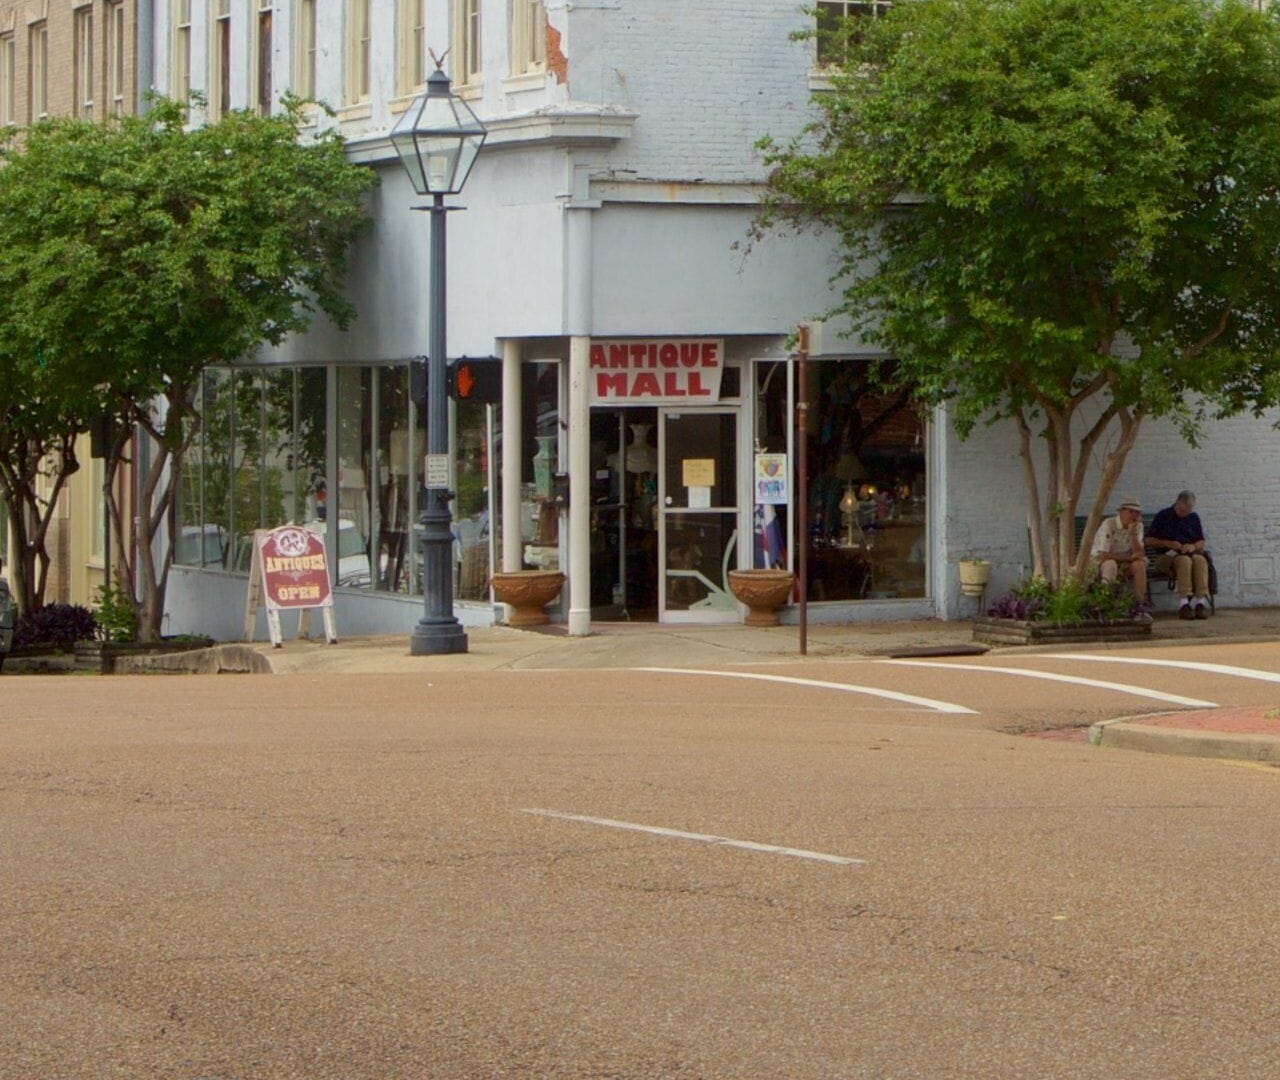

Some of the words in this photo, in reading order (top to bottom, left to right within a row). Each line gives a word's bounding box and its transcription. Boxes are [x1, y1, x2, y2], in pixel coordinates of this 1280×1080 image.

[590, 343, 718, 369] ANTIQUE
[597, 372, 711, 397] MALL
[266, 554, 325, 573] ANTIQUES
[278, 586, 320, 600] OPEN
